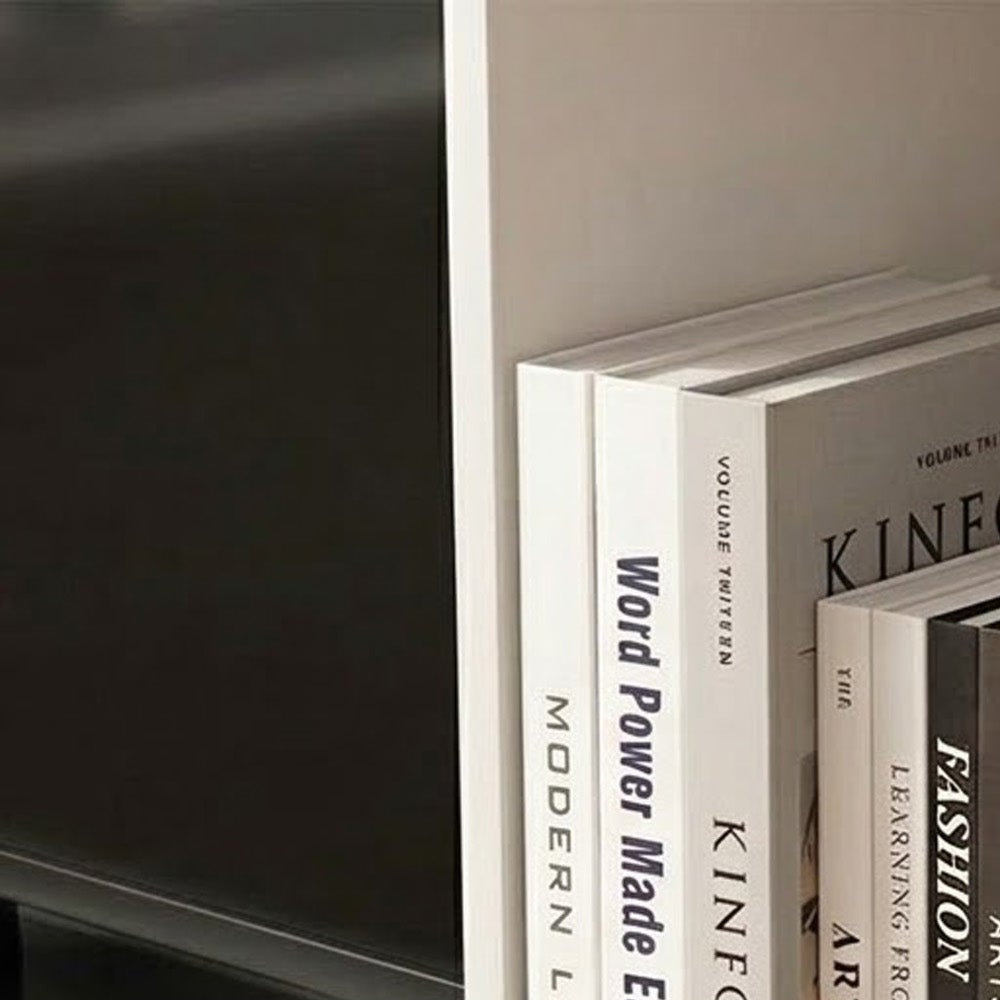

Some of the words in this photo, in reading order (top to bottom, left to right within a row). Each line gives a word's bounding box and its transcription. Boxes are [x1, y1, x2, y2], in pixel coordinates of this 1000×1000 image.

[616, 556, 660, 668] Word
[546, 694, 573, 935] MODERN
[619, 684, 662, 819] Power
[621, 835, 664, 955] Made
[936, 736, 971, 984] FASHION
